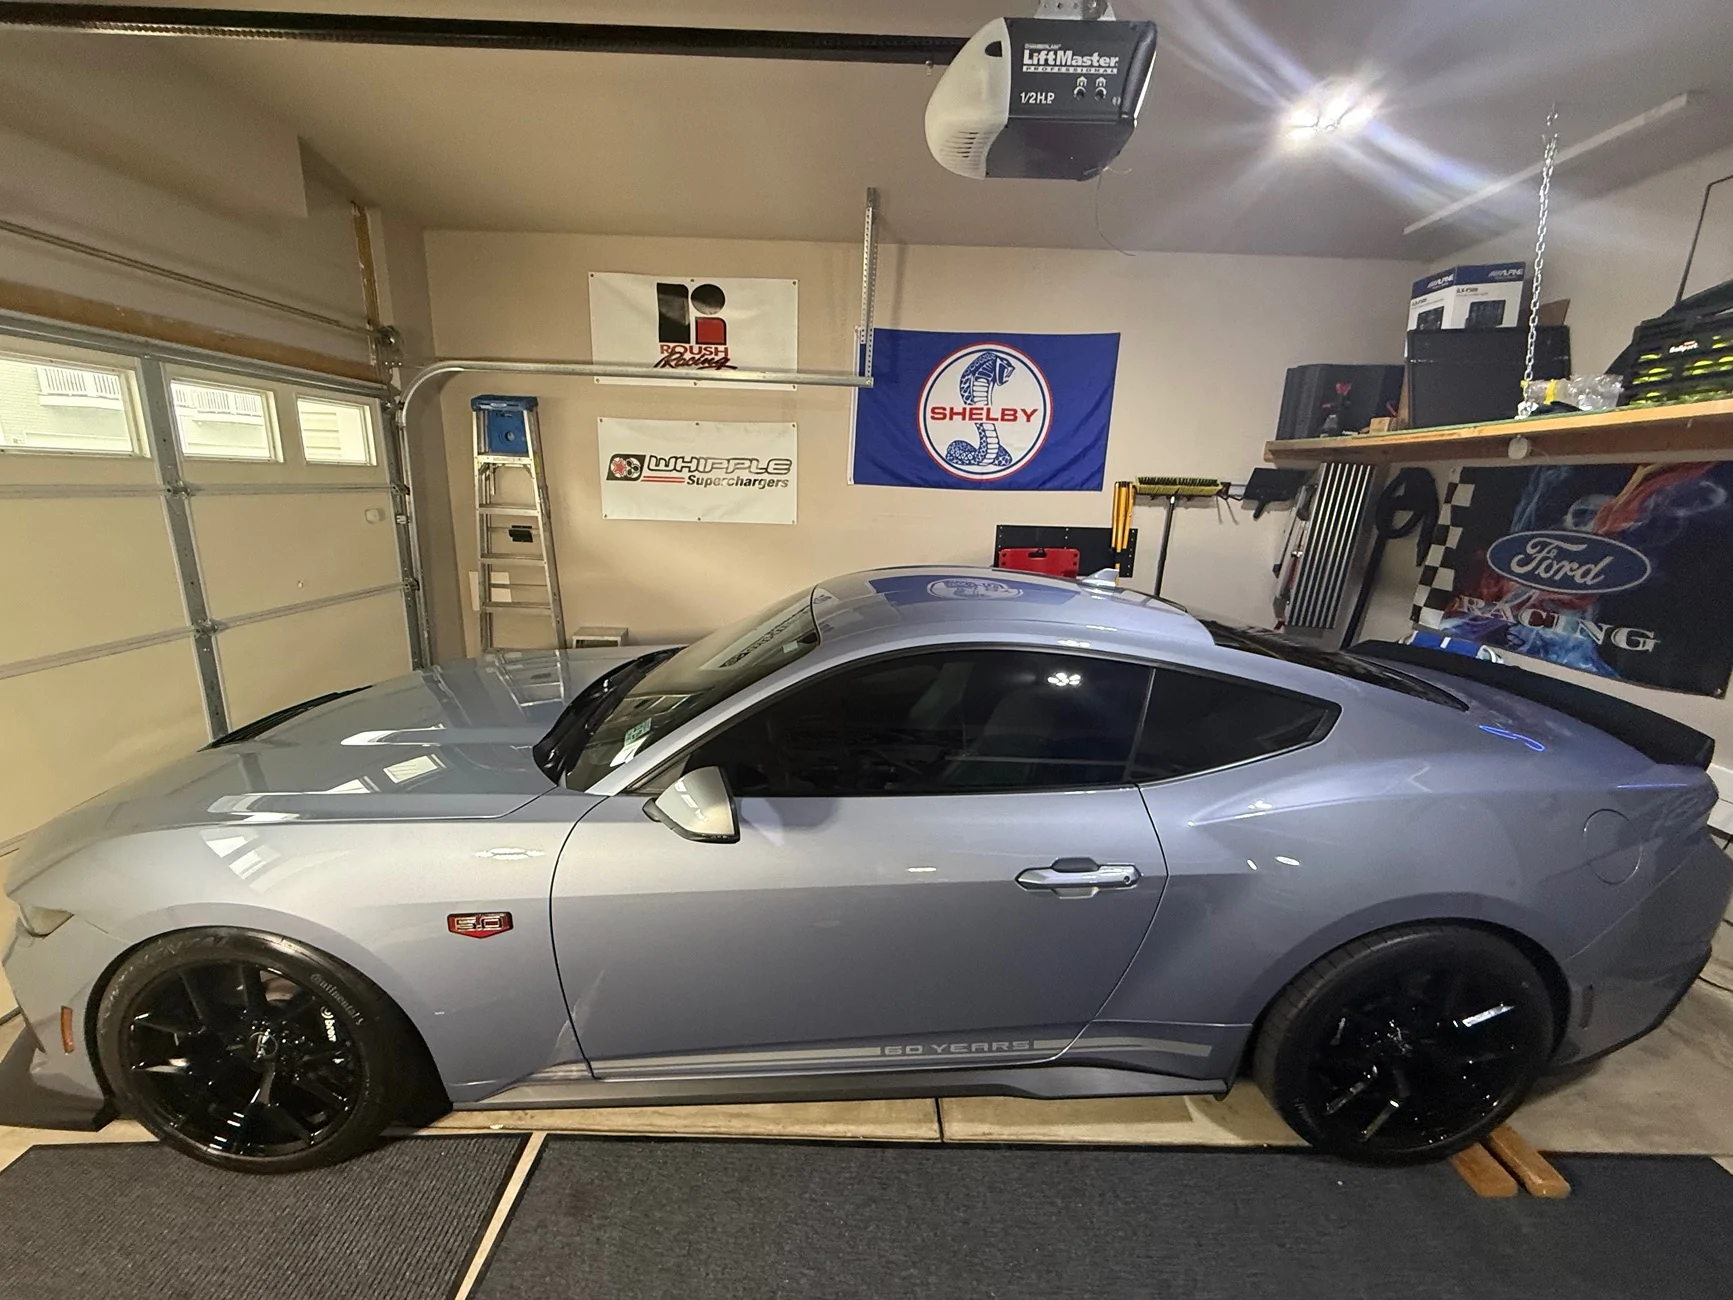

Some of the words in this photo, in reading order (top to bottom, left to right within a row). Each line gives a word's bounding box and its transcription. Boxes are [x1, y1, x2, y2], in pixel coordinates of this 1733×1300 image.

[1023, 49, 1119, 67] LiftMaster
[660, 344, 729, 357] ROUSH
[653, 351, 738, 370] Racing
[930, 406, 1039, 423] SHELBY
[647, 455, 792, 475] WHIPPLE
[687, 475, 789, 489] Superchargers
[1510, 537, 1613, 585] Ford
[1460, 596, 1660, 652] RACING
[455, 914, 504, 931] 5.0
[311, 973, 361, 1018] Continental
[885, 1046, 923, 1055] 60
[930, 1040, 1030, 1053] YEARS
